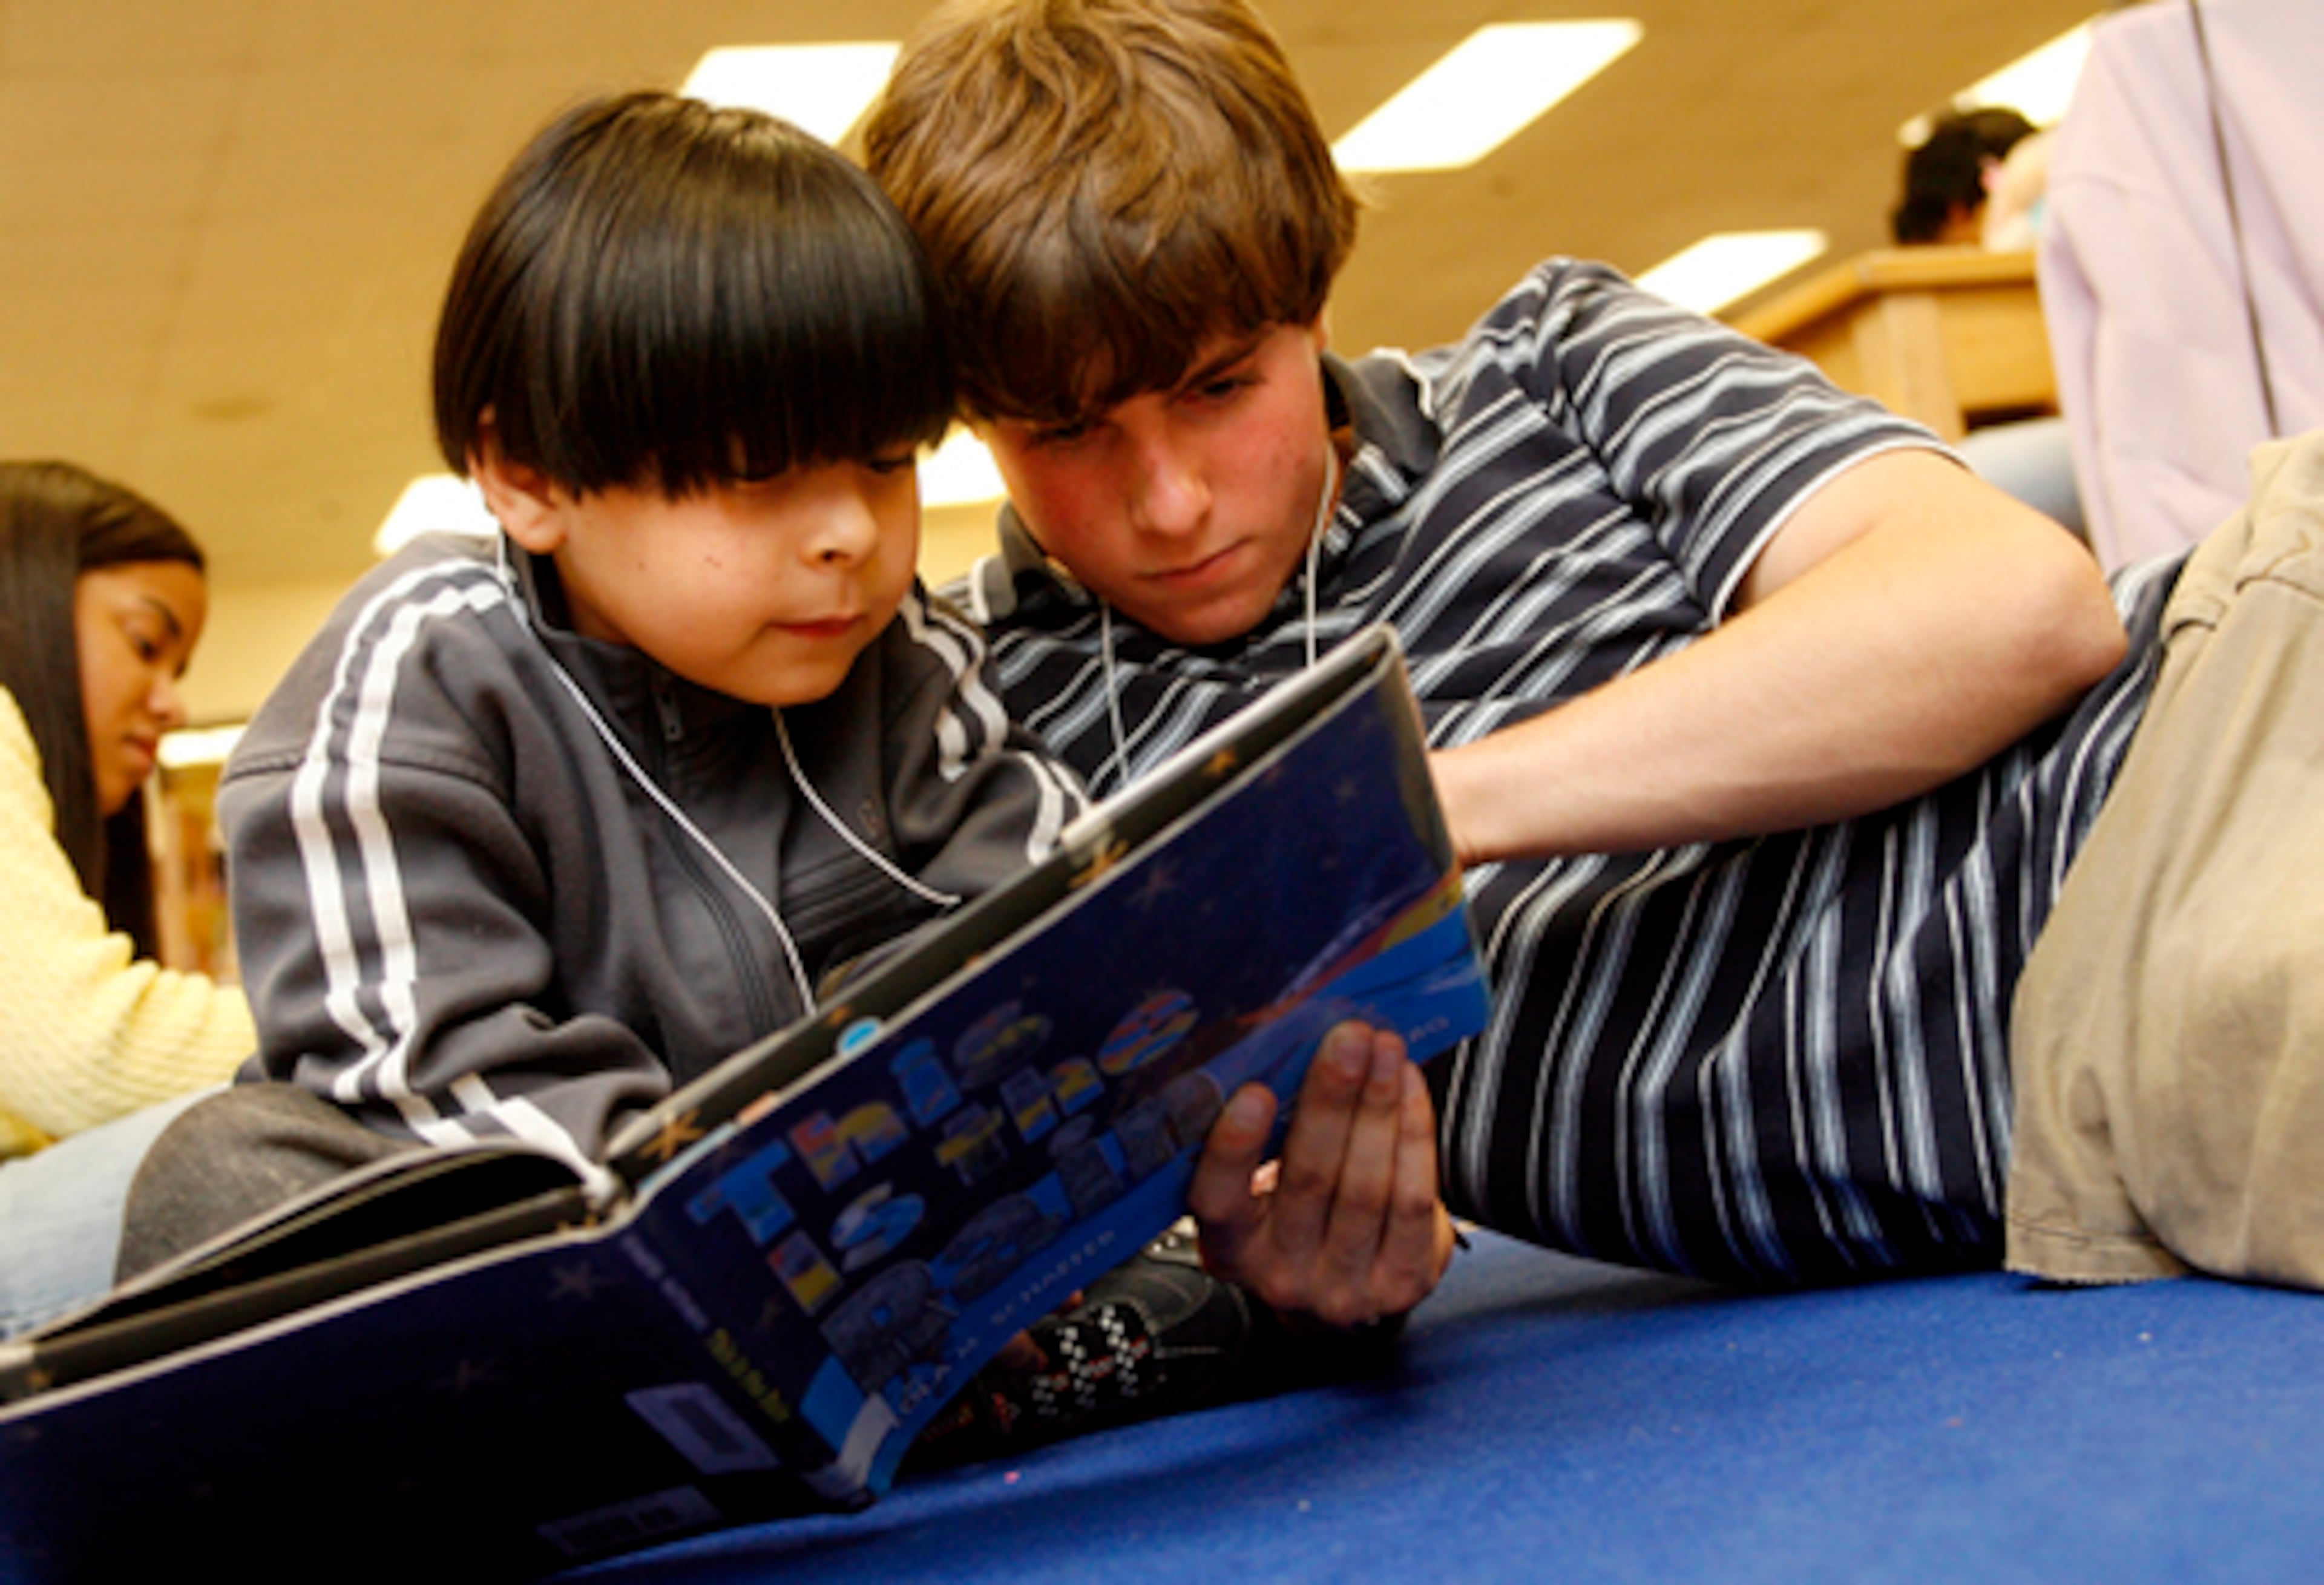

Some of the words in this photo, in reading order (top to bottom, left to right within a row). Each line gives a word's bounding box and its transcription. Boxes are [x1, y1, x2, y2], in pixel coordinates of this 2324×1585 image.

[684, 1000, 1053, 1245] This
[934, 988, 1200, 1188] the
[818, 1070, 1225, 1394] Rain
